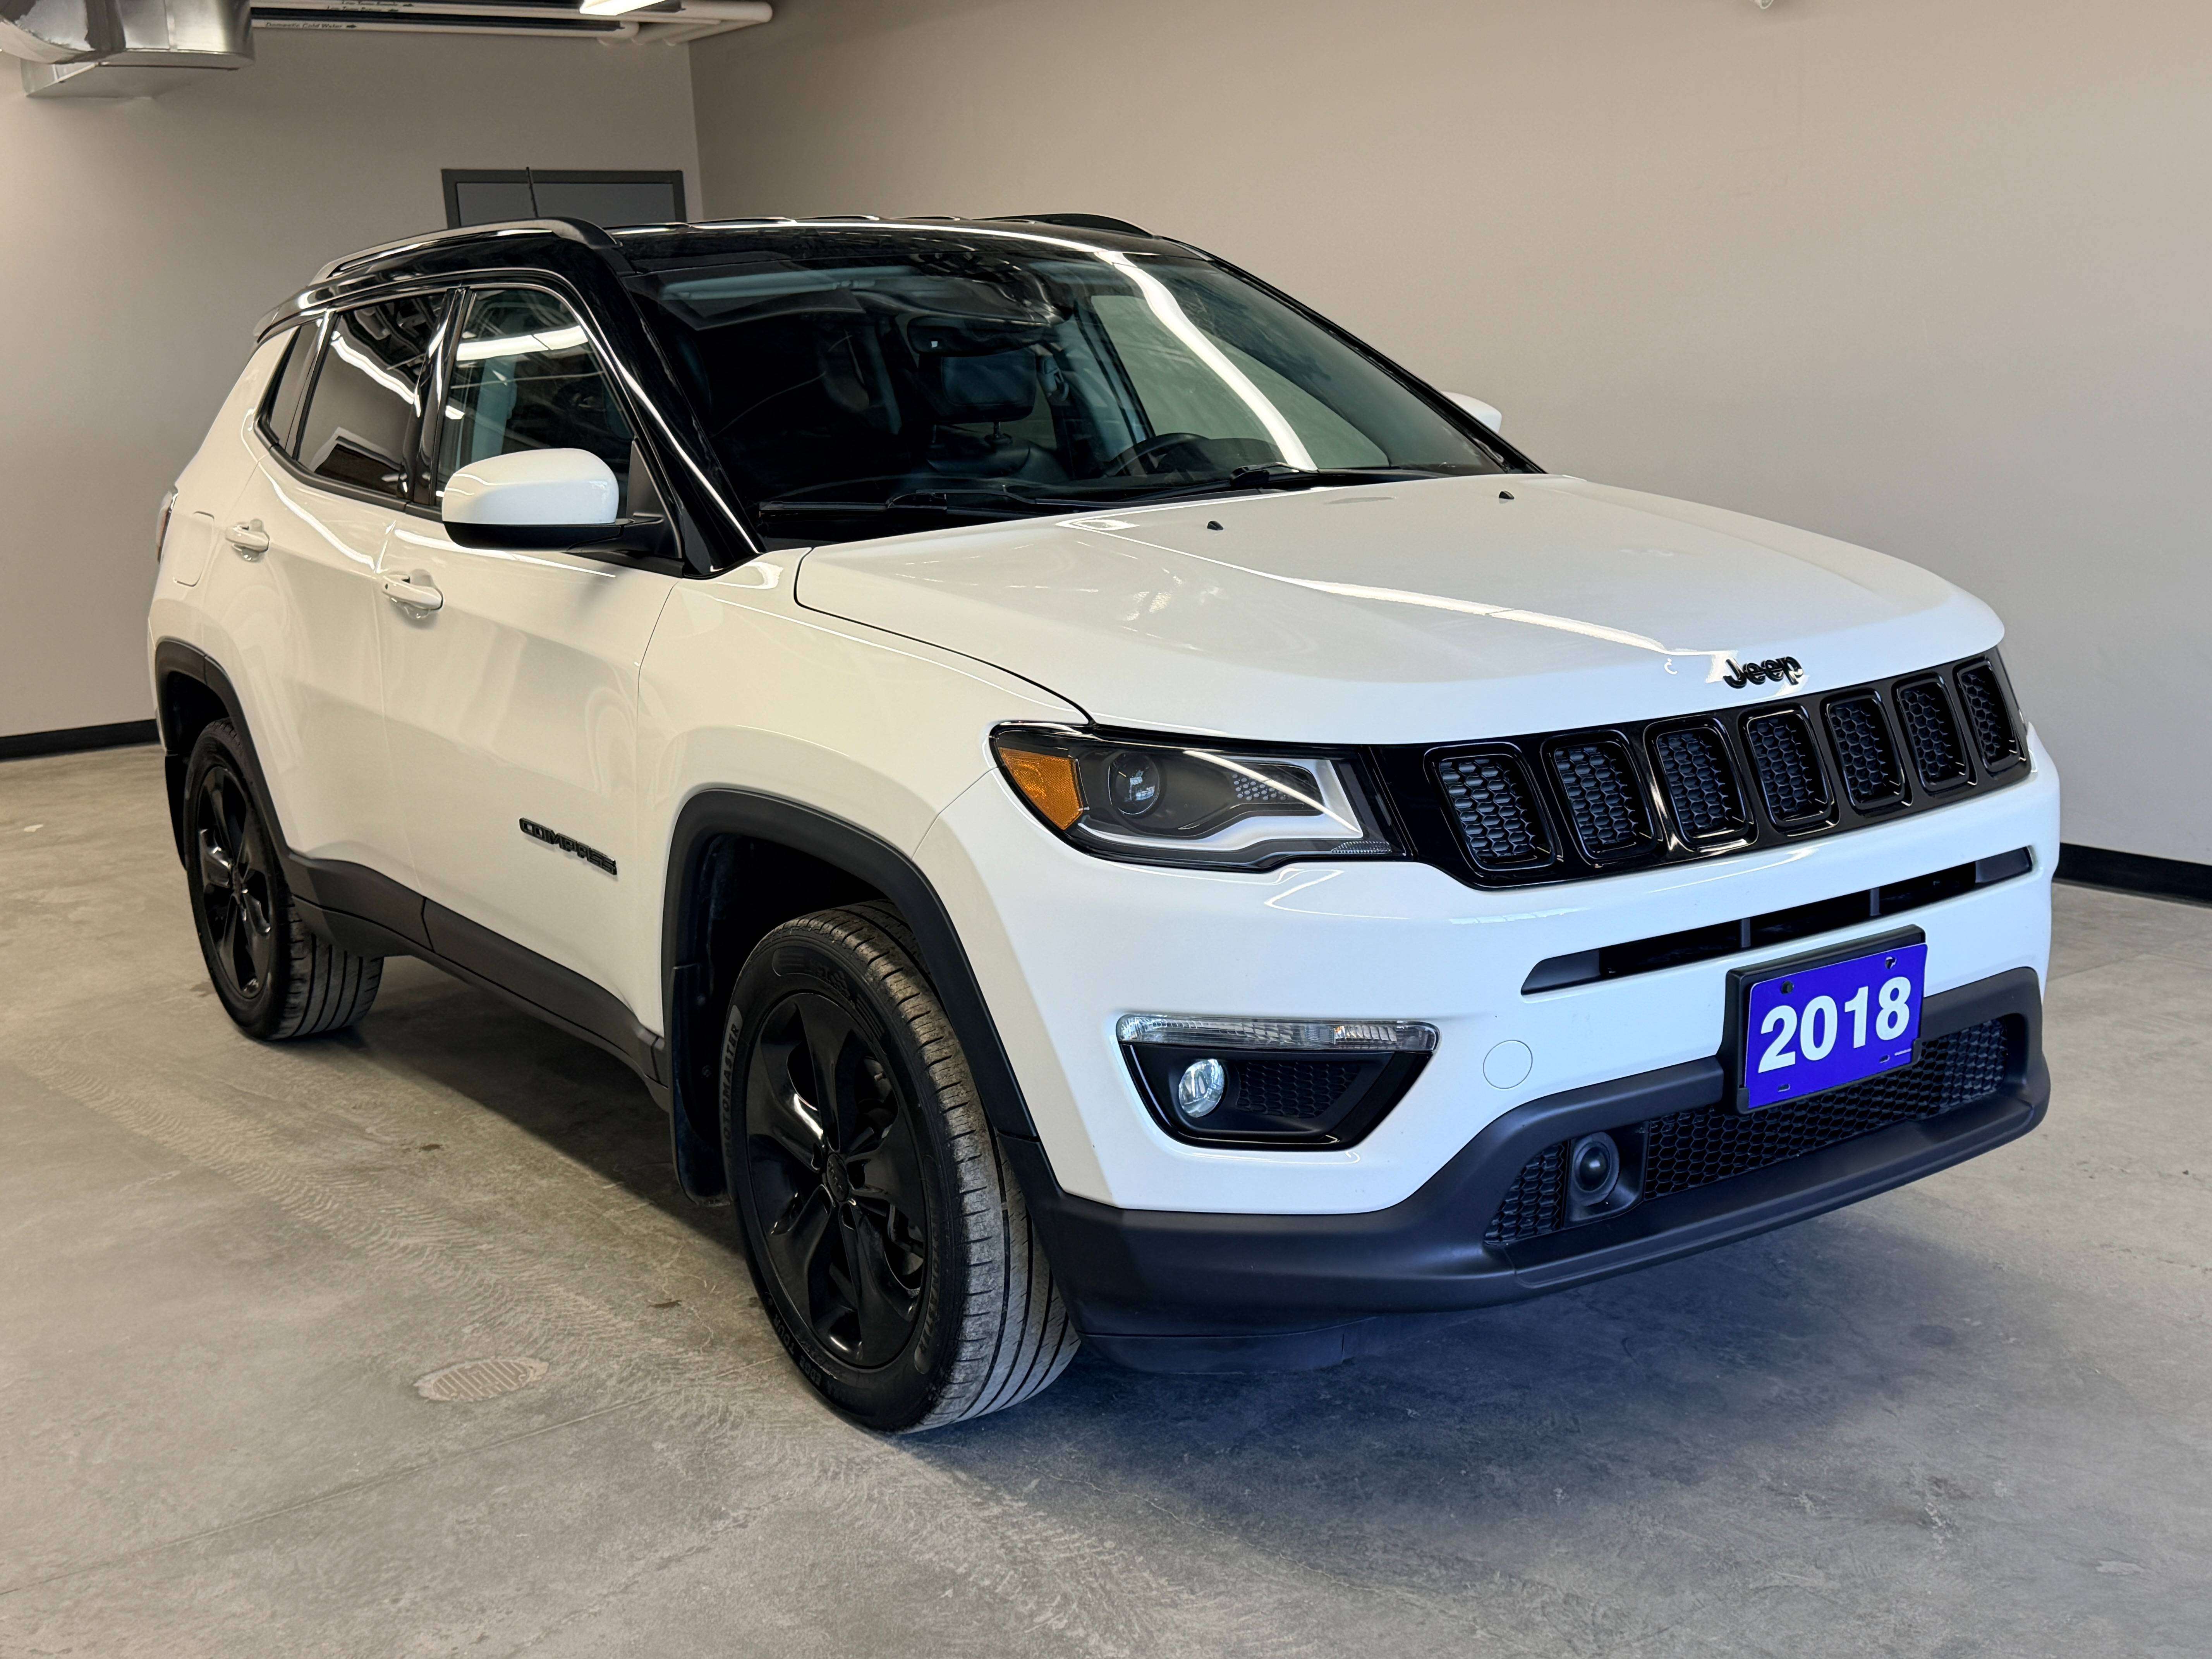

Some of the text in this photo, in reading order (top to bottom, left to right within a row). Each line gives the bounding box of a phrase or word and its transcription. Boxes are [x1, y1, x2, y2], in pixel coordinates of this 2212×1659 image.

[1723, 656, 1803, 689] Jeep
[519, 817, 617, 875] COMPASS
[1758, 976, 1911, 1073] 2018
